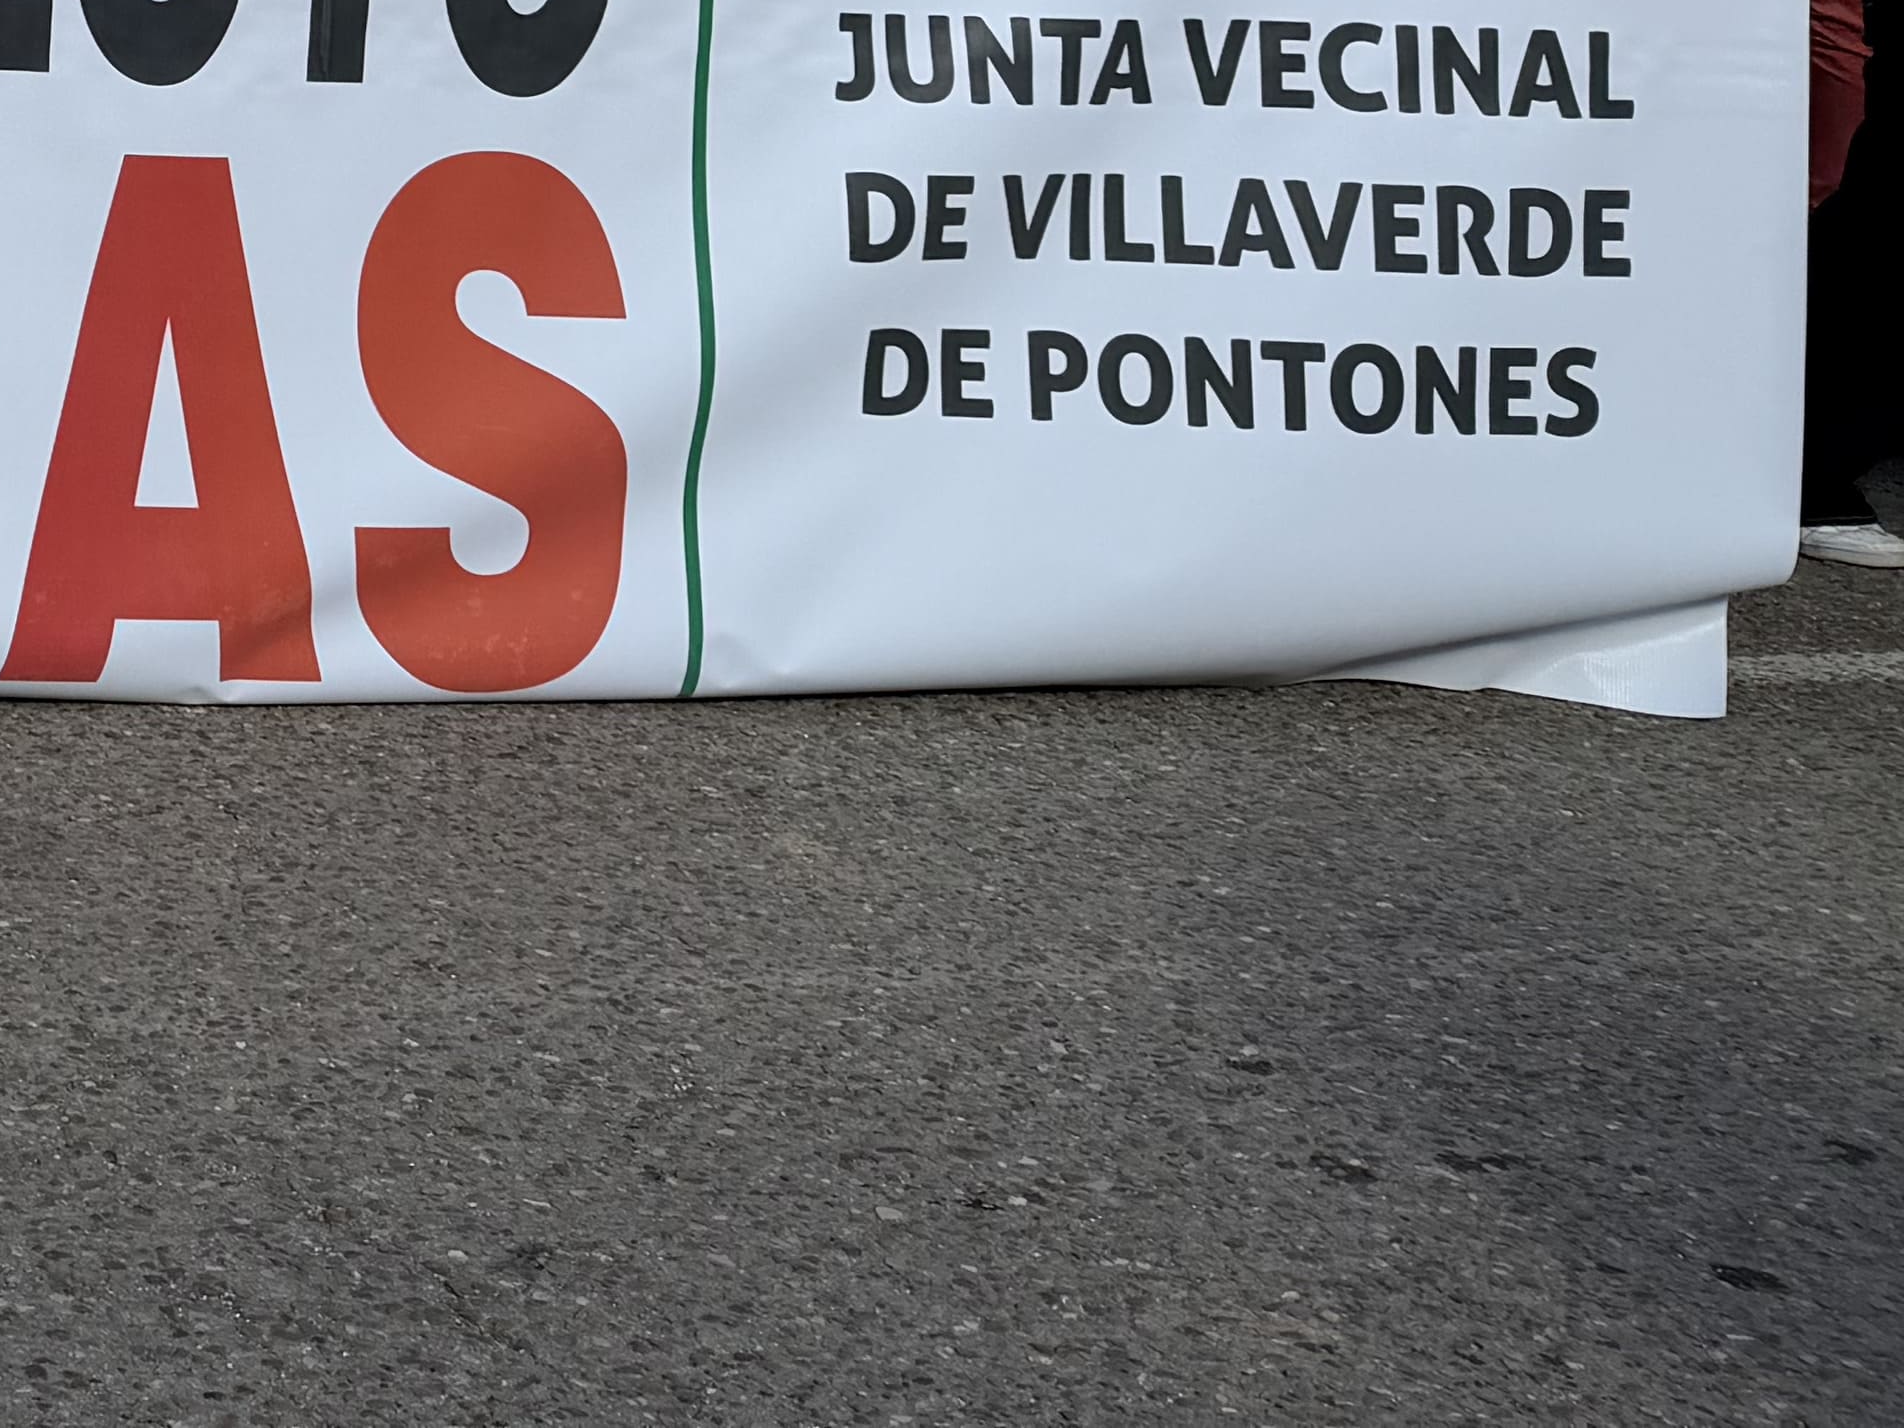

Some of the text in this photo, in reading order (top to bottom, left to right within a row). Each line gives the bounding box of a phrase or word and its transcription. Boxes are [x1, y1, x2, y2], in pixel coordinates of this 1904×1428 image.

[836, 13, 1634, 119] JUNTA VECINAL
[846, 172, 1631, 277] DE VILLAVERDE
[863, 329, 1598, 437] DE PONTONES
